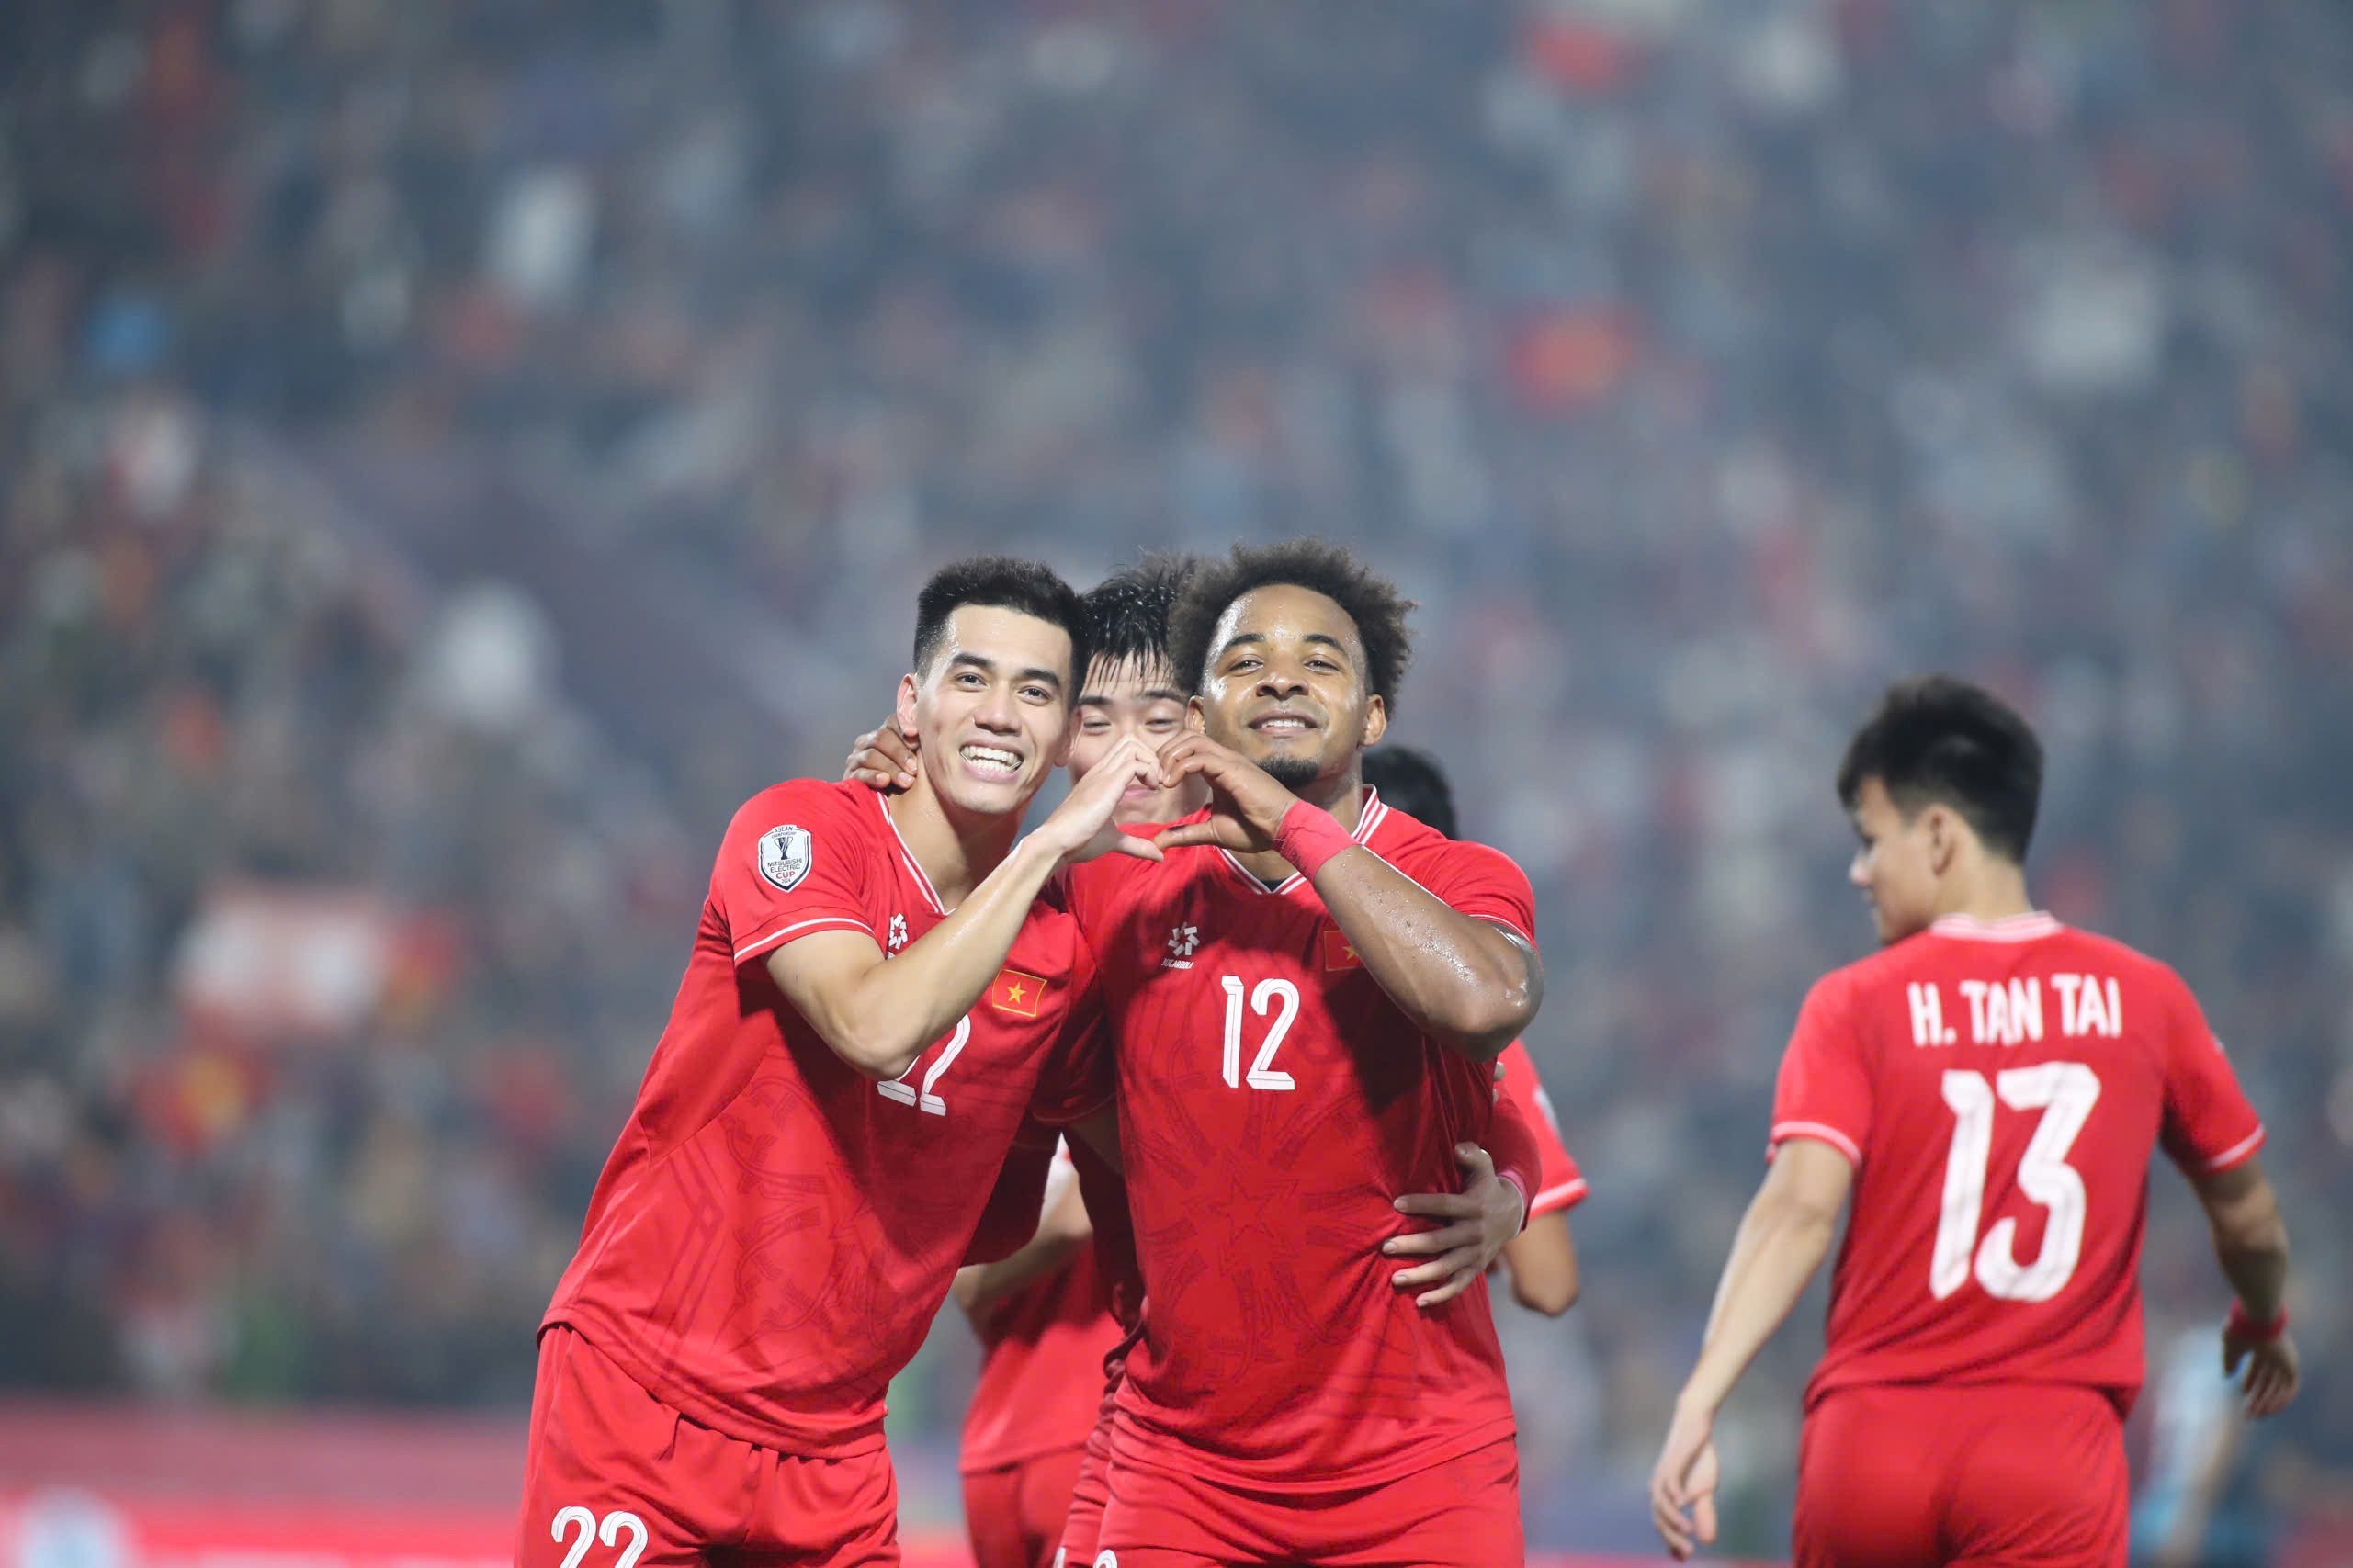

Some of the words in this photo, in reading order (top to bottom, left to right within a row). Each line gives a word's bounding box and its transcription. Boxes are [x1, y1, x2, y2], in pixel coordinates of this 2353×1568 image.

[767, 858, 802, 867] MITSUBISHI
[770, 864, 800, 874] ELECTRIC
[775, 871, 796, 879] CUP
[1907, 982, 1957, 1046] H.
[1959, 977, 2043, 1046] TAN
[2050, 973, 2122, 1038] TAI
[1221, 975, 1301, 1090] 12
[1929, 1060, 2102, 1303] 13
